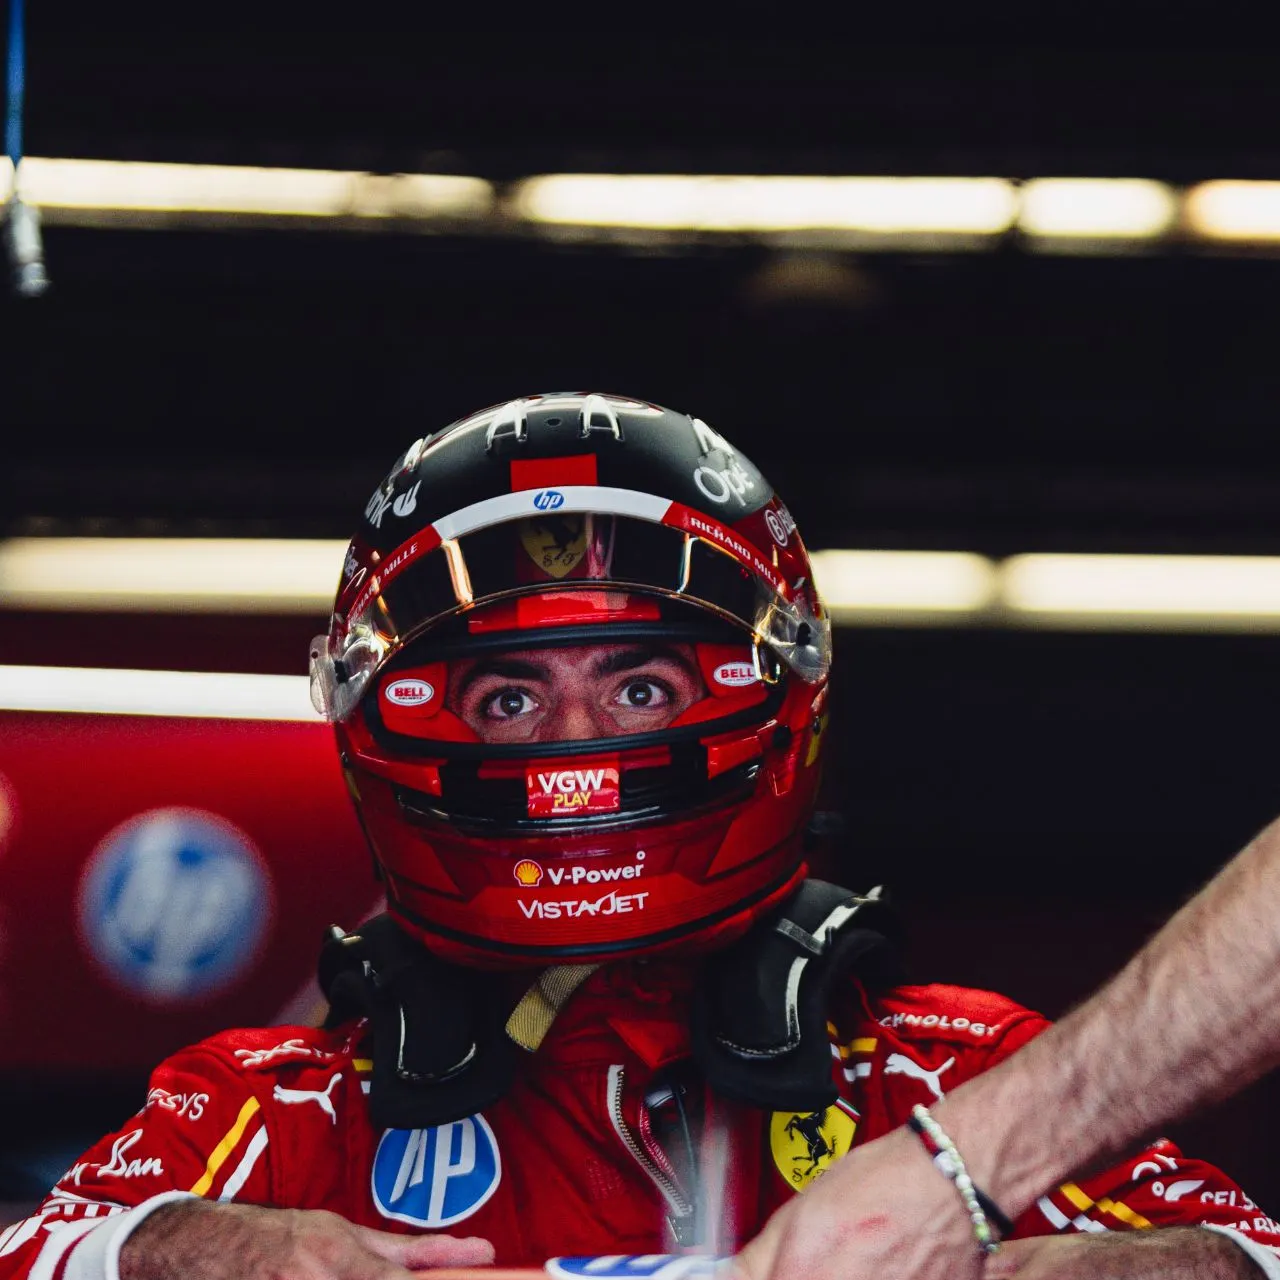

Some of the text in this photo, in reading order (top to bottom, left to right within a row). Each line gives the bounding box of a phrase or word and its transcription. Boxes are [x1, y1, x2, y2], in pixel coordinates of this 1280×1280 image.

[535, 491, 564, 514] hp
[690, 517, 752, 560] RICHARD
[383, 542, 418, 577] MILLE
[721, 667, 754, 679] BELL
[394, 687, 426, 697] BELL
[538, 769, 605, 794] VGW
[554, 791, 592, 808] PLAY
[548, 864, 645, 886] V-Power
[517, 889, 650, 920] VISTAJET
[876, 1012, 1001, 1037] CHNOLOGY
